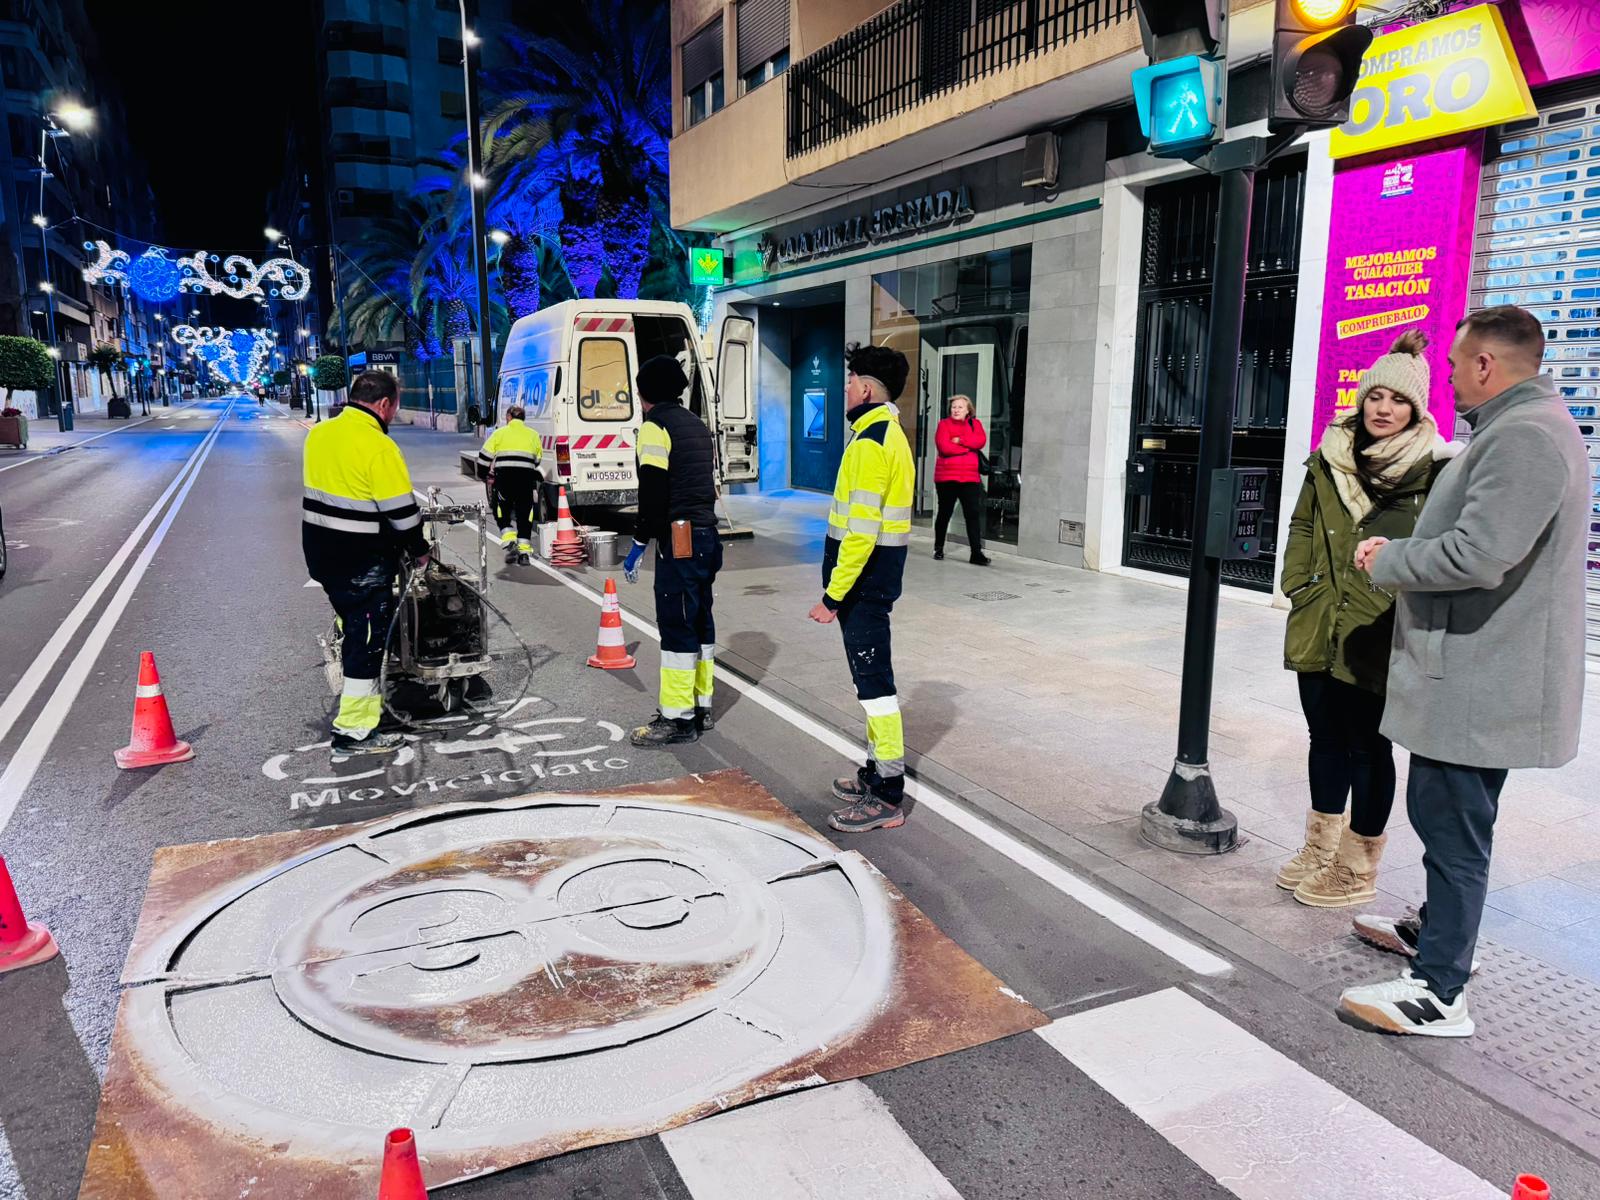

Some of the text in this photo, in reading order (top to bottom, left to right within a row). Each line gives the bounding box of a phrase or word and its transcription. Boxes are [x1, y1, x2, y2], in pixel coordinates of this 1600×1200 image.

[1358, 23, 1482, 79] OMPRAMOS
[1338, 56, 1490, 136] ORO
[869, 185, 975, 236] GRANADA
[1344, 246, 1437, 269] MEJORAMOS
[1353, 262, 1424, 280] CUALQUIER
[1344, 275, 1431, 300] TASACIÓN
[372, 353, 395, 361] BBVA
[599, 471, 619, 480] 0592
